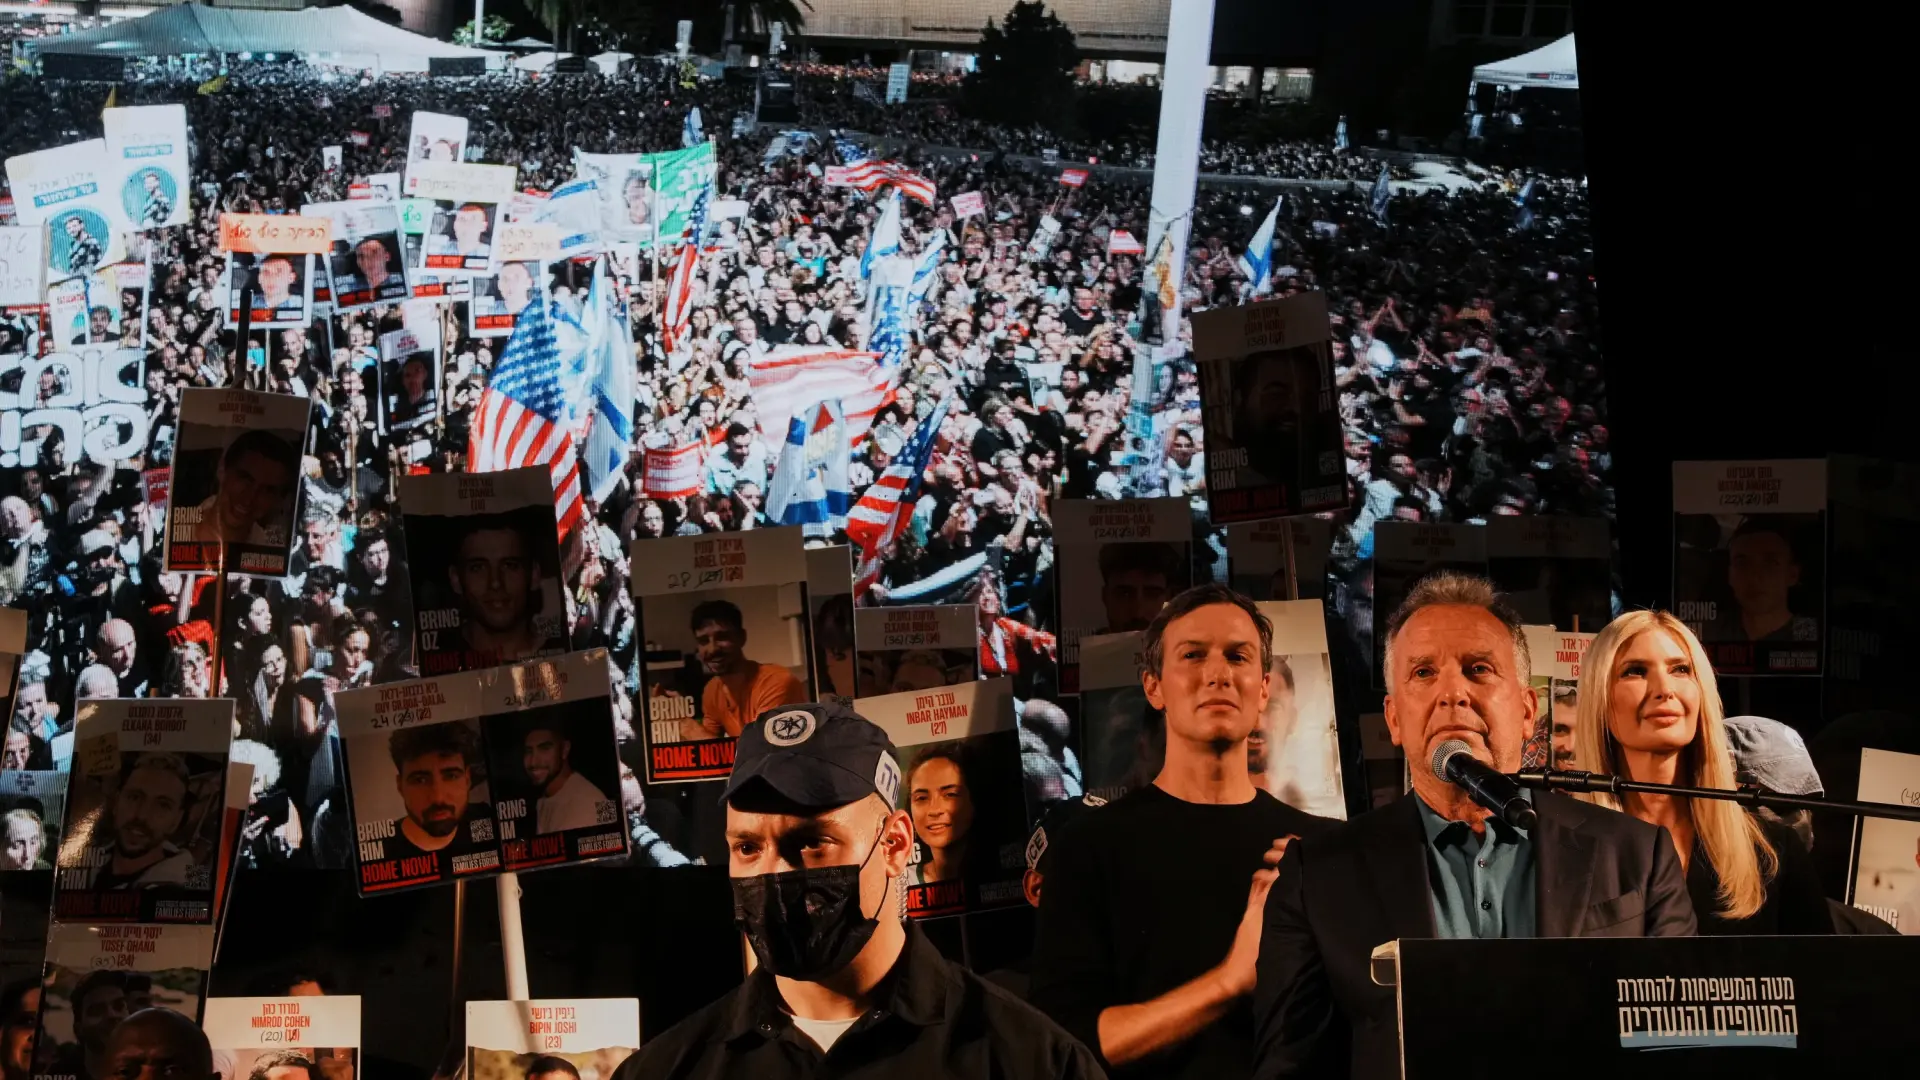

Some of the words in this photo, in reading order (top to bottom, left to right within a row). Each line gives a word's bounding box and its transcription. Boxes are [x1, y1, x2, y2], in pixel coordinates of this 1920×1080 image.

[1210, 446, 1248, 470] BRING
[1212, 470, 1236, 491] HIM
[174, 506, 203, 524] BRING
[172, 524, 194, 542] HIM
[172, 544, 198, 562] HOME
[694, 554, 718, 568] ARIEL
[419, 608, 460, 630] BRING
[1679, 601, 1717, 621] BRING
[422, 630, 440, 651] OZ
[1562, 638, 1576, 650] אדר
[1578, 638, 1592, 650] מיר
[424, 651, 460, 672] HOME
[1556, 651, 1579, 663] TAMIR
[1572, 664, 1580, 677] (3
[375, 702, 390, 714] GUY
[916, 695, 934, 710] הימן
[936, 692, 955, 706] ענבר
[650, 696, 695, 721] BRING
[906, 707, 932, 725] INBAR
[934, 704, 968, 720] HAYMAN
[122, 719, 154, 732] ELKANA
[155, 719, 187, 732] BOHBOT
[371, 714, 389, 728] 24
[930, 722, 947, 736] (27)
[144, 732, 162, 746] (34)
[650, 720, 680, 744] HIM
[652, 745, 696, 769] HOME
[700, 741, 735, 766] NOW
[496, 798, 527, 820] RING
[358, 818, 396, 843] BRING
[500, 820, 516, 840] IM
[358, 842, 384, 863] HIM
[502, 841, 528, 862] OME
[531, 832, 566, 858] NOW!
[578, 840, 602, 854] FAMILIES
[603, 837, 622, 851] FORUM
[1028, 833, 1044, 864] ICE
[361, 860, 398, 885] HOME
[402, 851, 440, 879] NOW!
[452, 858, 478, 874] FAMILIES
[479, 855, 499, 870] FORUM
[60, 868, 87, 890] HIM
[908, 888, 924, 909] ME
[926, 878, 965, 906] NOW!
[100, 893, 140, 916] NOW!
[155, 908, 186, 918] FAMILIES
[187, 908, 208, 919] FORUM
[1853, 903, 1898, 930] ING
[144, 926, 162, 940] יוסף
[101, 940, 124, 953] YOSEF
[126, 940, 156, 954] OHANA
[117, 954, 134, 968] (24)
[1617, 975, 1675, 1003] להחזרת
[1680, 977, 1756, 1003] המשפחות
[1760, 977, 1795, 1002] מטה
[262, 1004, 276, 1016] כהן
[279, 1003, 300, 1014] נמרוד
[556, 1007, 576, 1020] ביפין
[252, 1016, 282, 1028] NIMROD
[284, 1016, 310, 1028] COHEN
[530, 1022, 552, 1034] BIPIN
[554, 1022, 577, 1034] JOSHI
[1620, 1005, 1708, 1038] והנעדרים
[1713, 1005, 1798, 1036] החטופים
[260, 1030, 282, 1044] (20)
[545, 1036, 562, 1049] (23)
